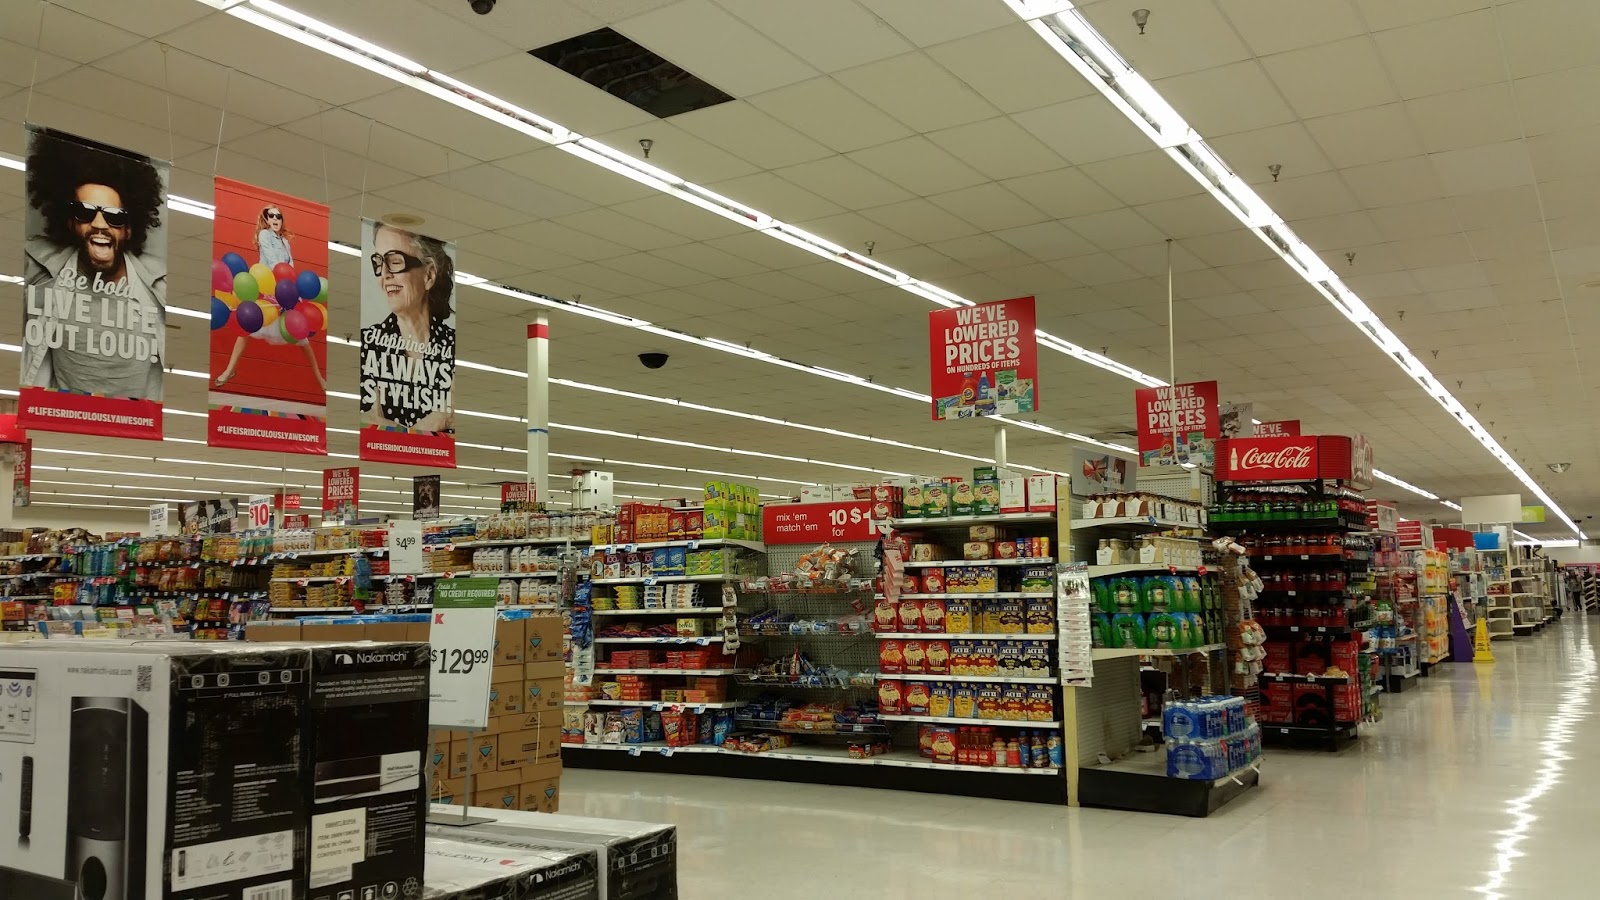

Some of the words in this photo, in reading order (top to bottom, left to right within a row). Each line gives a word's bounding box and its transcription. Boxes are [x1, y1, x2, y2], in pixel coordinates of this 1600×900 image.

[57, 267, 88, 291] Be
[93, 271, 136, 299] bold
[27, 285, 92, 323] LIVE
[101, 298, 158, 334] LIFE
[956, 304, 1006, 325] WE'VE
[945, 320, 1019, 344] LOWERED
[25, 319, 80, 351] OUT
[87, 328, 158, 364] LOUD!
[363, 328, 438, 355] Happiness
[441, 344, 452, 358] is
[945, 337, 1020, 366] PRICES
[363, 350, 452, 388] ALWAYS
[946, 366, 956, 374] ON
[957, 362, 990, 373] HUNDREDS
[991, 361, 999, 369] OF
[1001, 359, 1020, 368] ITEMS
[363, 379, 452, 414] STYLISH!
[1156, 385, 1195, 400] WE'VE
[1148, 397, 1205, 413] LOWERED
[27, 406, 154, 427] #LIFEISRIDICULOUSLYAWESOME
[1148, 408, 1206, 429] PRICES
[217, 425, 320, 443] #LIFEISRIDICULOUSLYAWESOME
[366, 442, 450, 457] #LIFEISRIDICULOUSLYAWESOME
[1241, 446, 1315, 470] Coca-Cola
[328, 476, 354, 486] LOWERED
[328, 485, 354, 496] PRICES
[506, 491, 527, 499] LOWERE
[250, 503, 269, 527] $10
[776, 513, 790, 521] mix
[793, 513, 807, 521] 'em
[829, 509, 847, 526] 10
[776, 524, 801, 532] match
[832, 527, 845, 537] for
[440, 590, 448, 598] NO
[448, 590, 467, 598] CREDIT
[467, 590, 495, 598] REQUIRED
[434, 614, 445, 624] K
[357, 651, 407, 664] Nakamichi
[545, 861, 581, 881] Nakamichi
